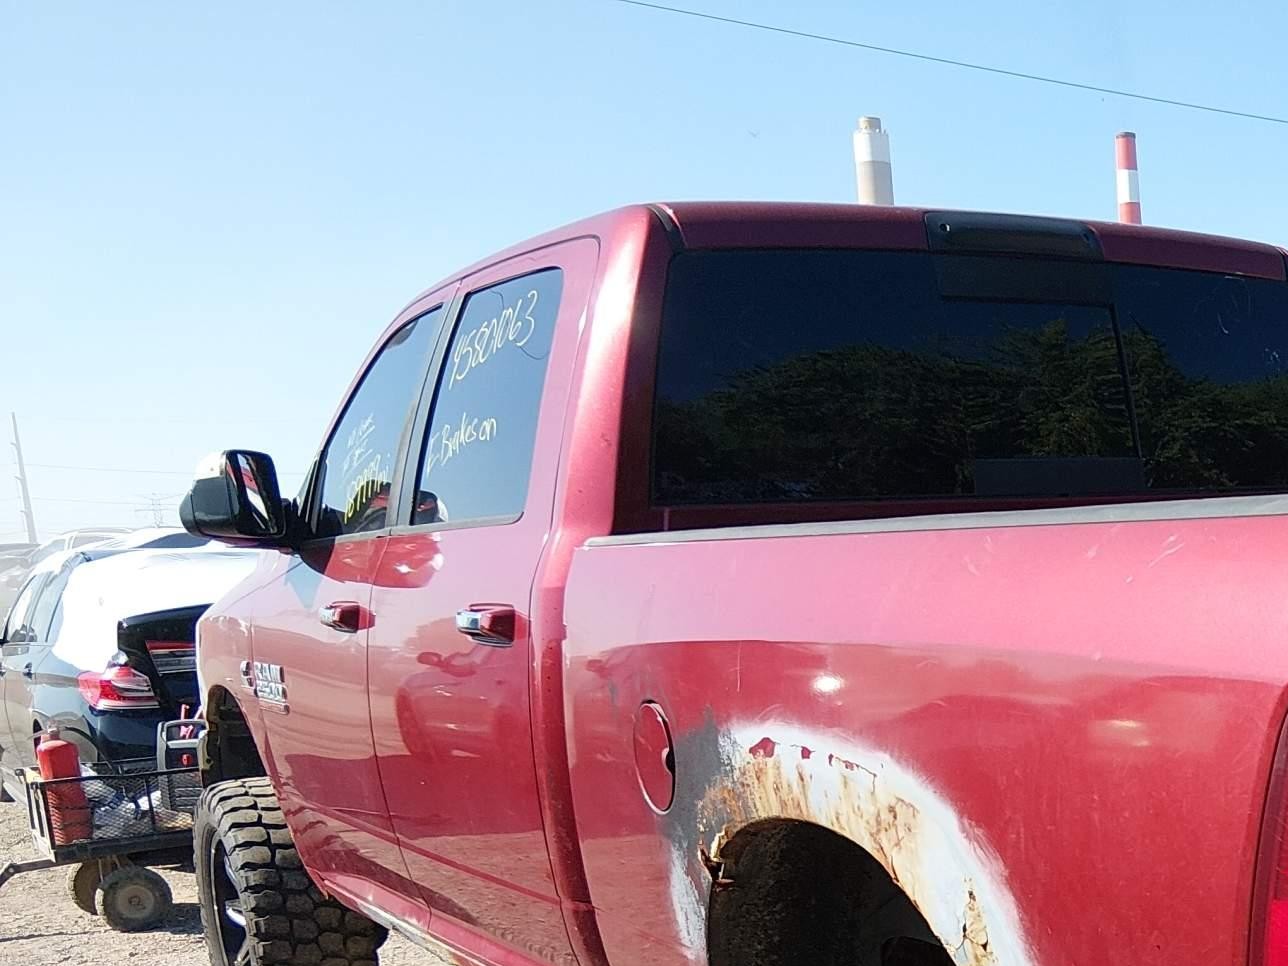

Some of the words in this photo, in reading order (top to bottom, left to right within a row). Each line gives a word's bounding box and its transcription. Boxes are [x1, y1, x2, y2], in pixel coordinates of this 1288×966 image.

[448, 289, 538, 390] 45801063
[478, 417, 497, 441] on
[253, 661, 282, 682] RAM
